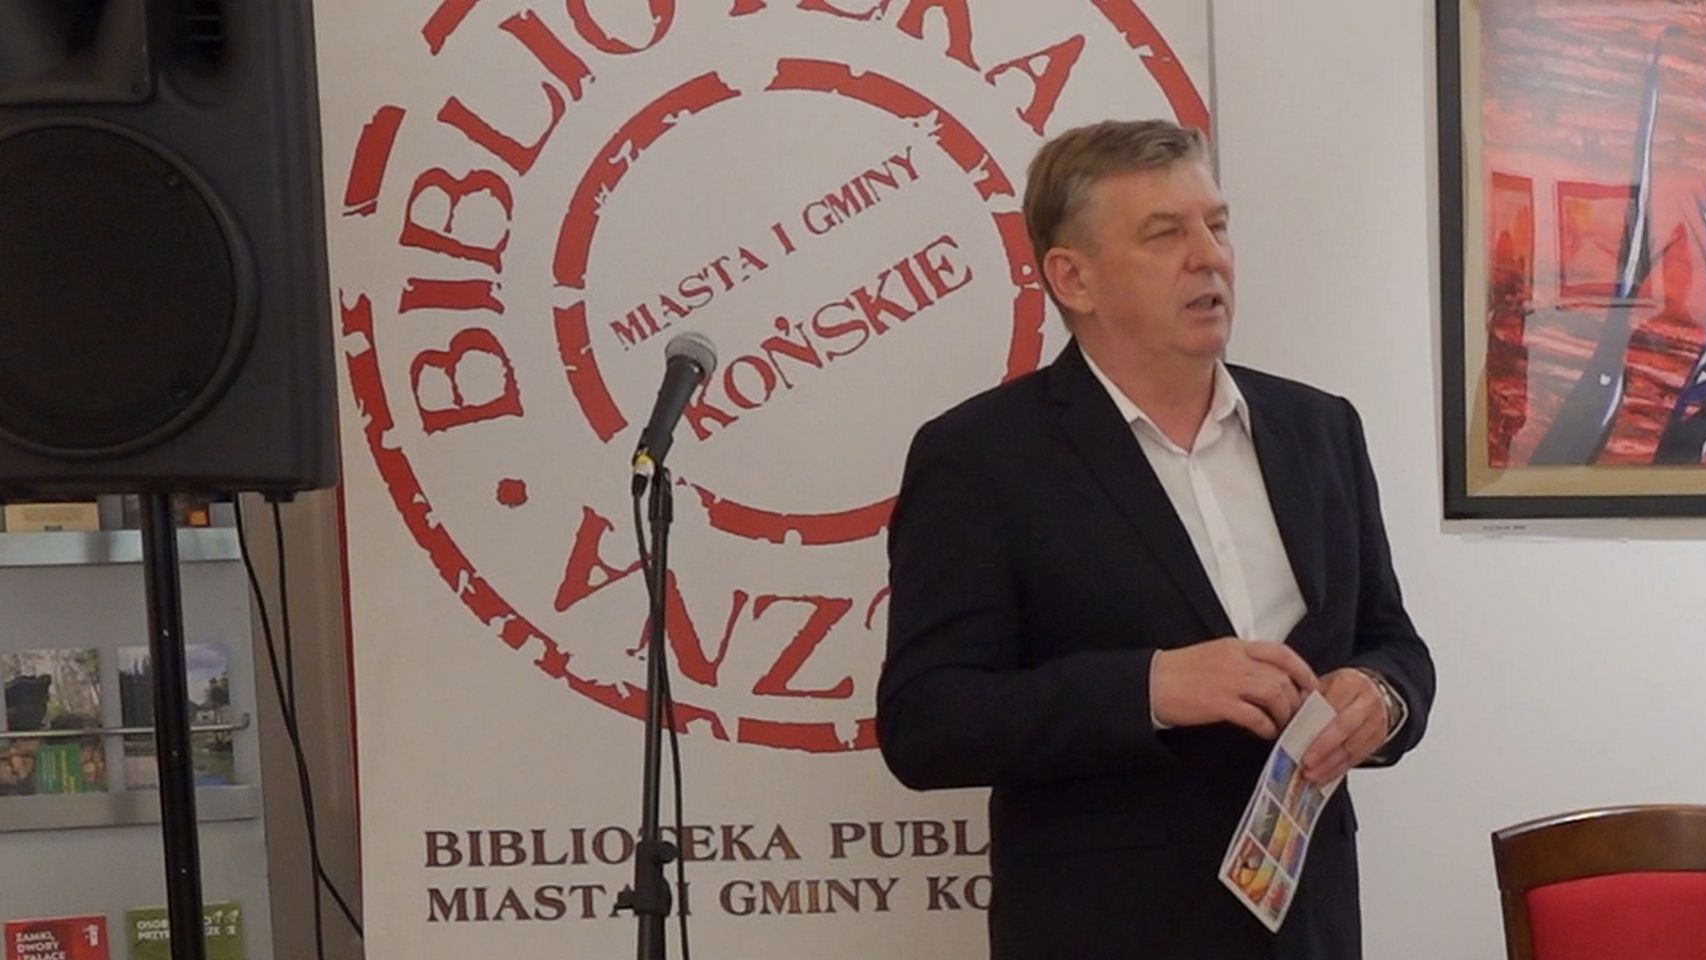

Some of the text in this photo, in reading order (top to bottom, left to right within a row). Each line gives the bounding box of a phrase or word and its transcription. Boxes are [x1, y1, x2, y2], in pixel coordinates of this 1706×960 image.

[609, 146, 919, 351] MIASTA I GMINY
[682, 235, 974, 441] KOŃSKIE
[829, 819, 993, 860] PUBL
[718, 877, 900, 916] GMINY
[926, 875, 992, 912] KO
[137, 919, 170, 930] OSOB
